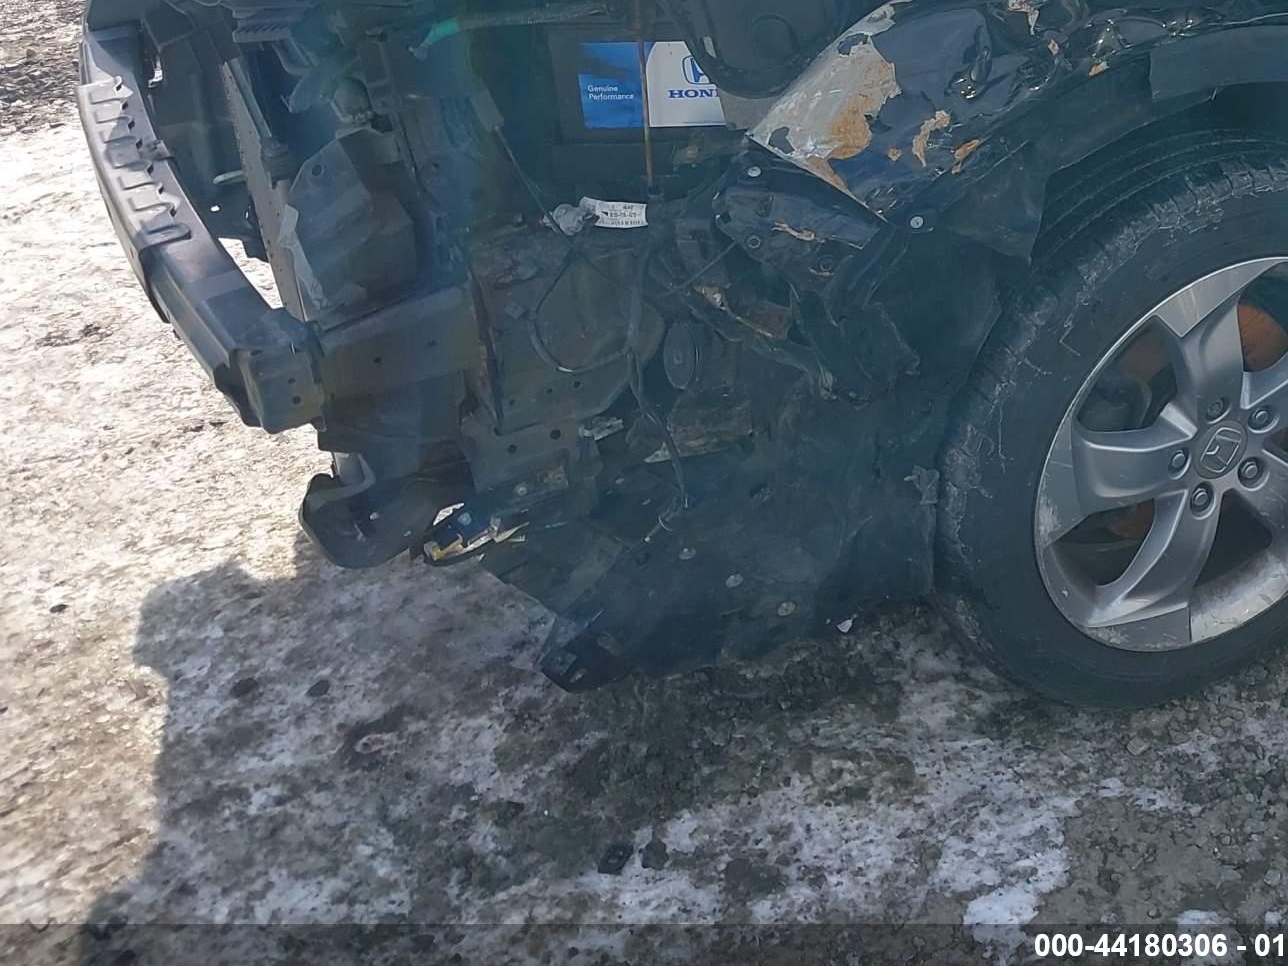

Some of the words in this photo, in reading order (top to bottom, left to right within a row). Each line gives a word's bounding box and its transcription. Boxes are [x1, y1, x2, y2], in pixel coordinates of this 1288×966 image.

[587, 84, 618, 93] Genuine
[588, 93, 635, 101] Performance
[667, 89, 718, 99] HON
